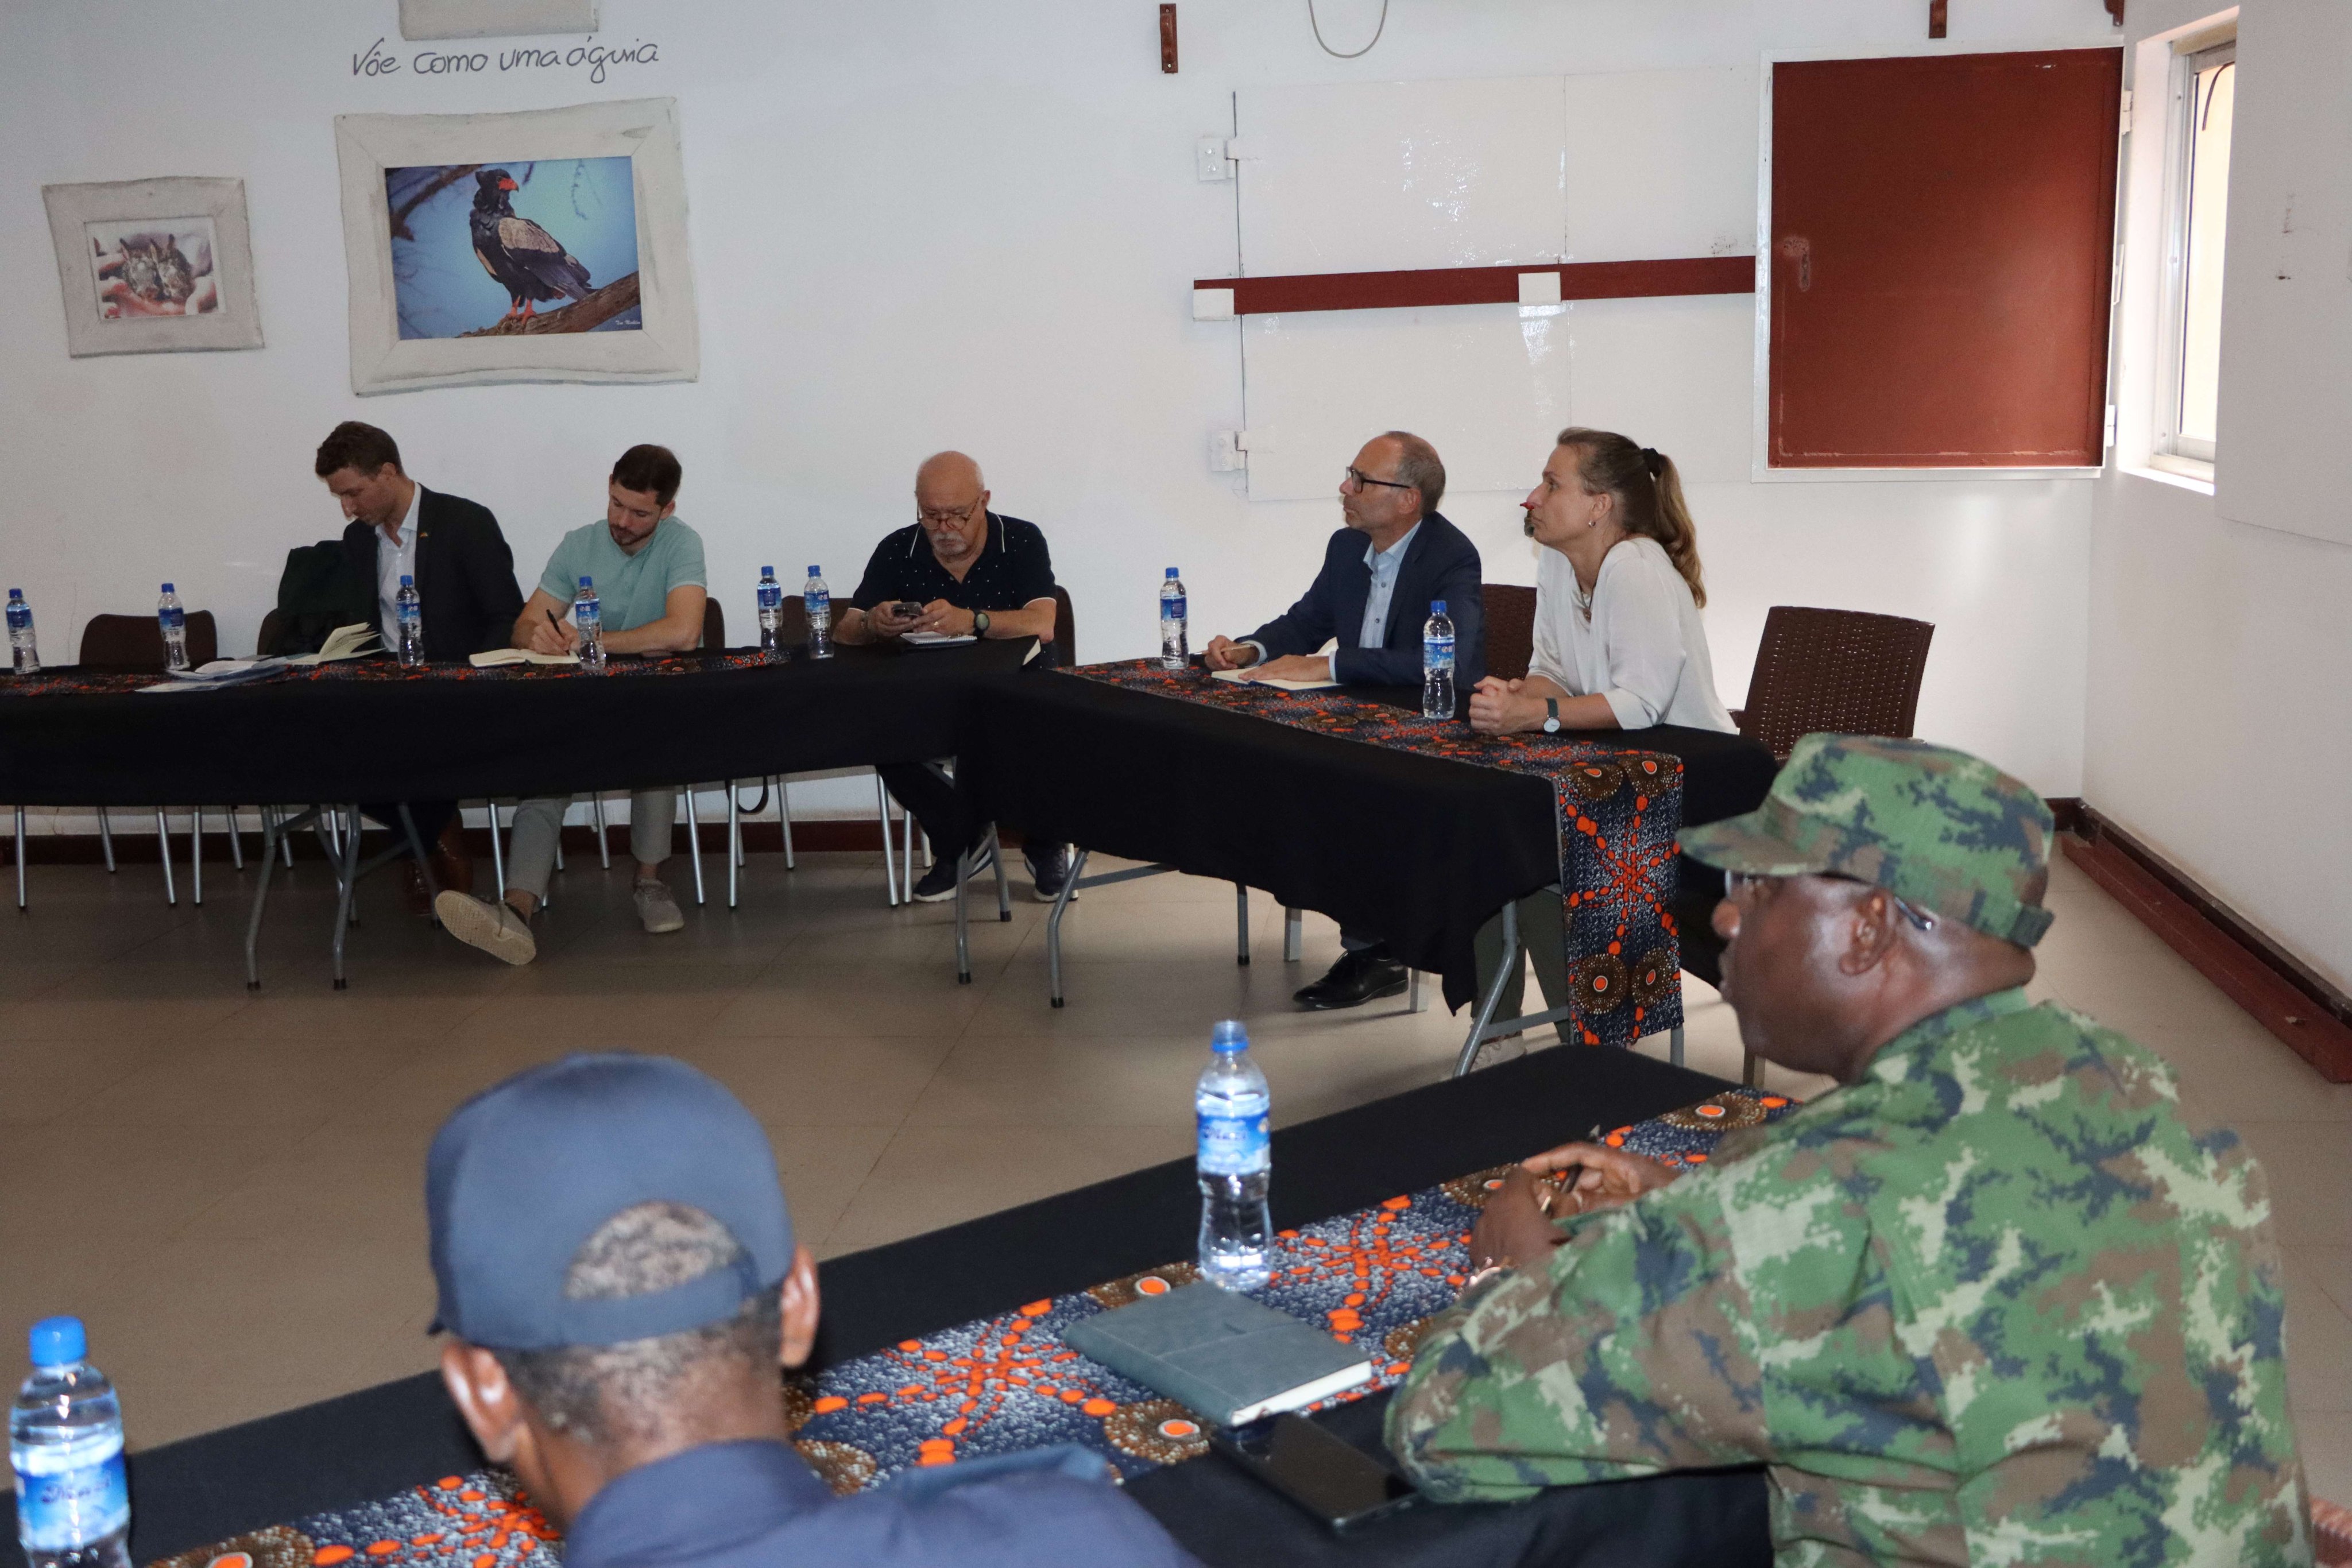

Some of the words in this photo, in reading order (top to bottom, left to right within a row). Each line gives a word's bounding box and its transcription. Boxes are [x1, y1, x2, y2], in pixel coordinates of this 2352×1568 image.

[353, 37, 401, 77] Vôe
[413, 52, 489, 75] como
[499, 49, 561, 71] uma
[566, 35, 659, 84] águia
